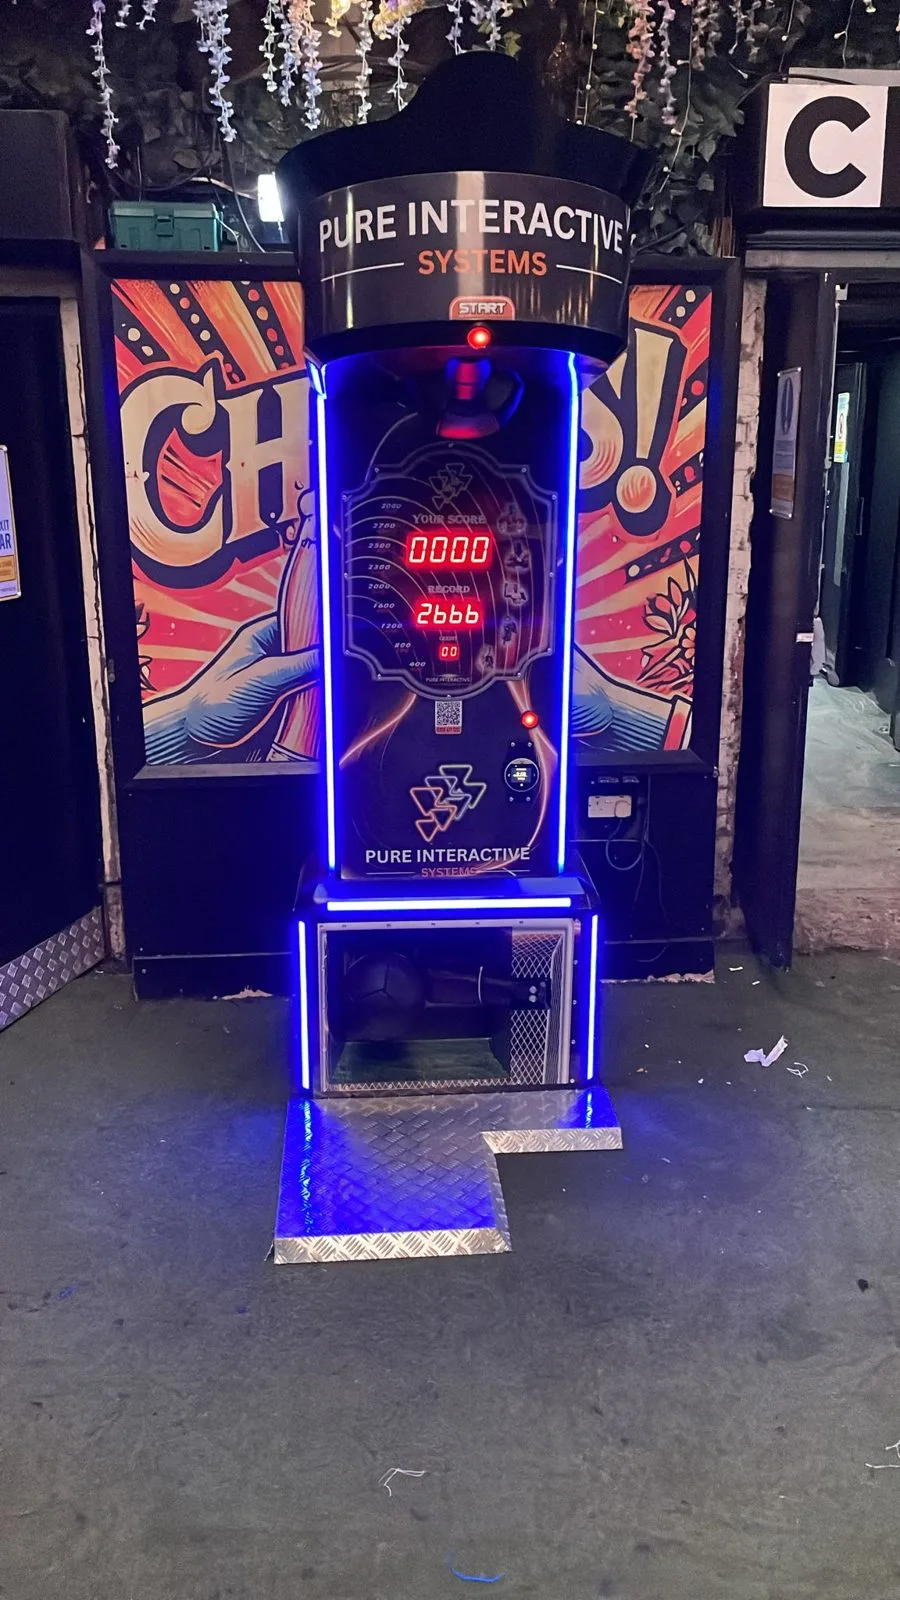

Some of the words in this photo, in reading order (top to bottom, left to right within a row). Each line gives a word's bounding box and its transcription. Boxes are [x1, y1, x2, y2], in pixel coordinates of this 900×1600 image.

[784, 96, 871, 198] C
[319, 204, 397, 252] PURE
[408, 199, 624, 254] INTERACTIVE
[418, 250, 547, 276] SYSTEMS
[458, 302, 508, 315] START
[412, 514, 445, 524] YOUR
[447, 514, 486, 524] SCORE
[408, 536, 490, 563] 0000
[427, 585, 471, 594] RECORD
[441, 646, 457, 657] 00
[365, 850, 412, 864] PURE
[416, 847, 531, 863] INTERACTIVE
[421, 867, 478, 878] SYSTEMS
